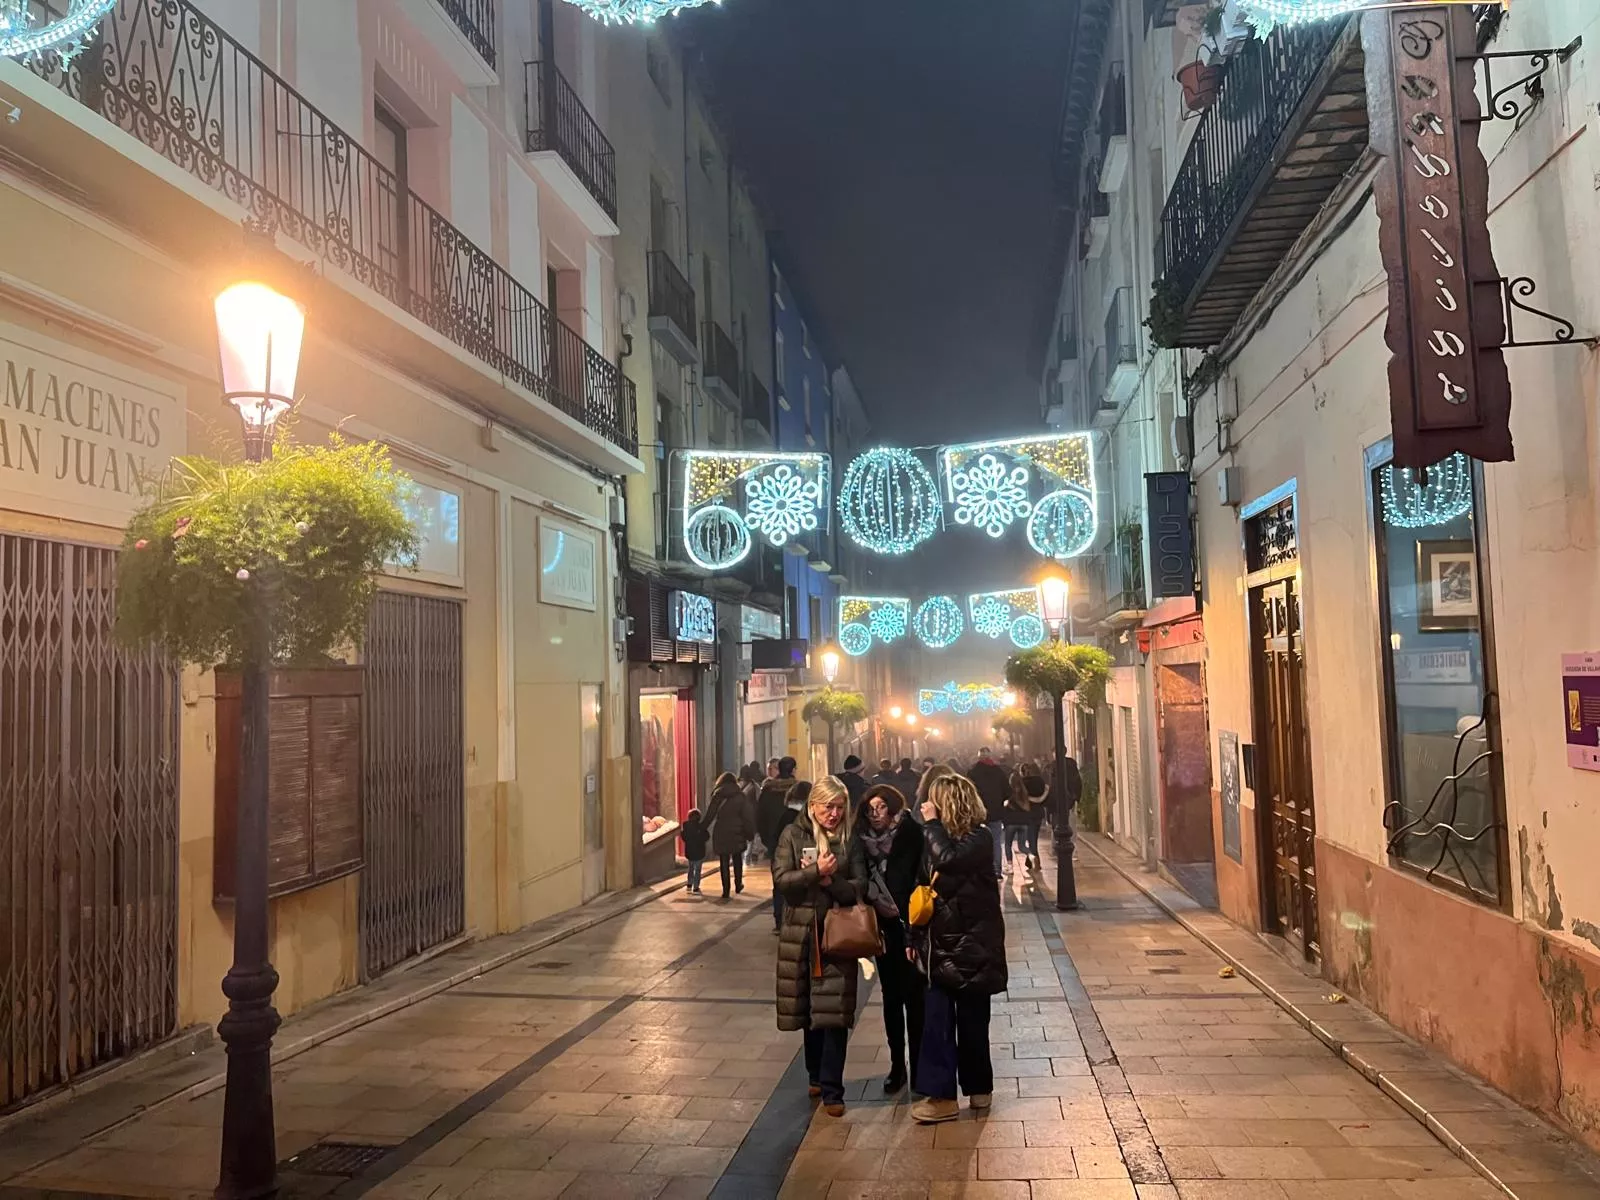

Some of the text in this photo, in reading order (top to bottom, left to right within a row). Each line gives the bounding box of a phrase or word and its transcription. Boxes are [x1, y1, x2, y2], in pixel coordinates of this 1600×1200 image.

[0, 359, 160, 448] MACENES
[56, 434, 146, 497] JUAN
[1156, 474, 1184, 594] DISCOS
